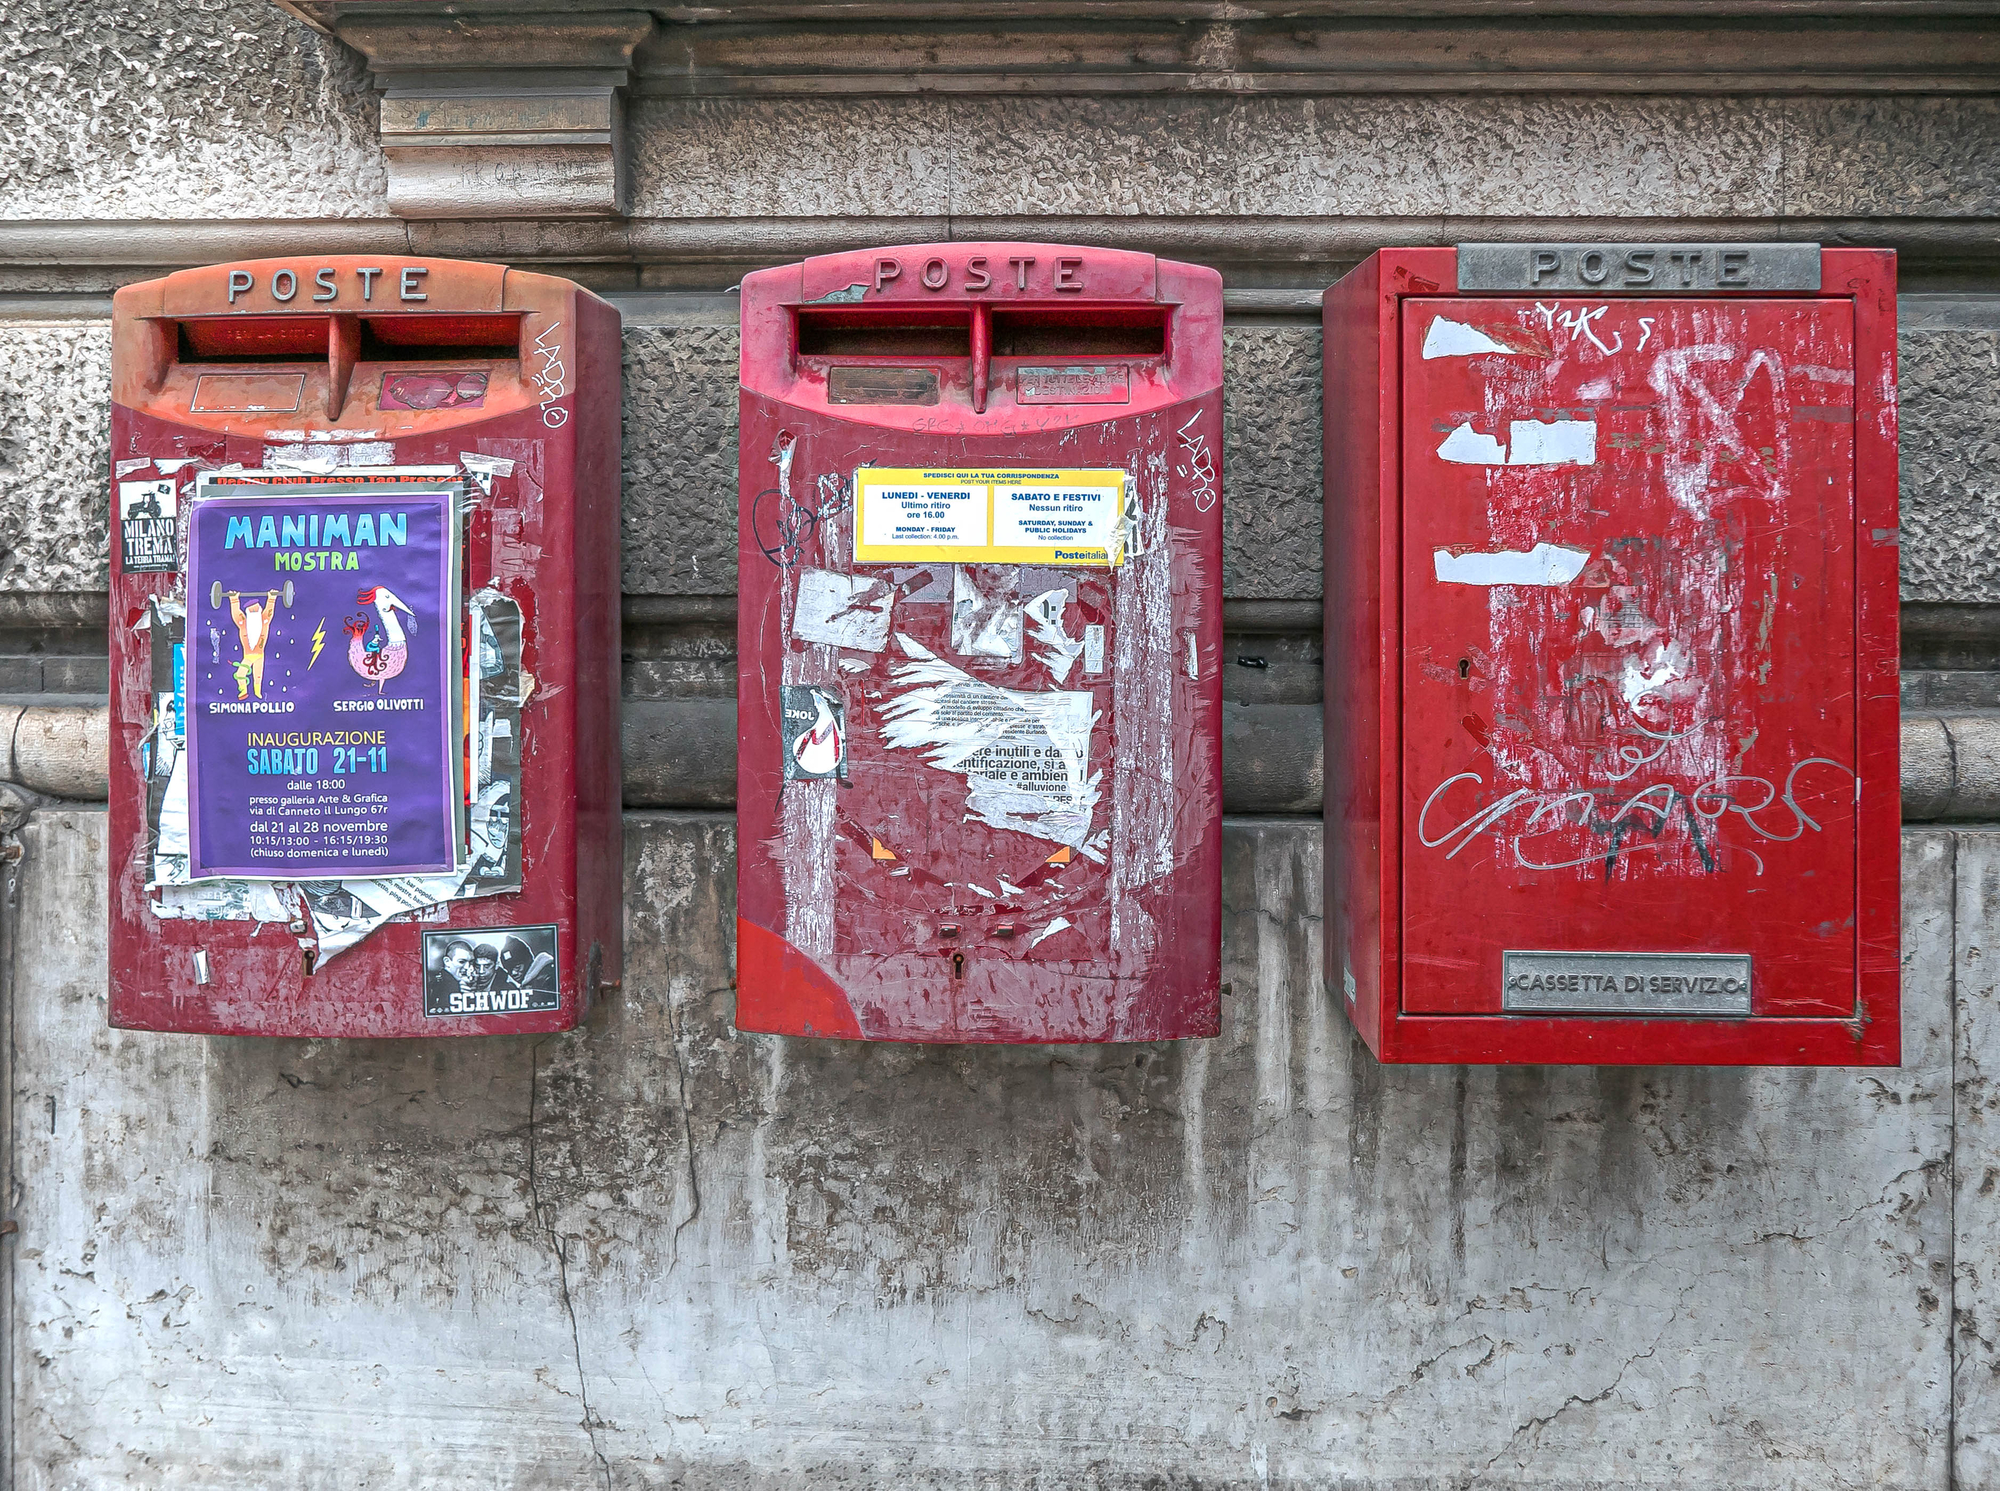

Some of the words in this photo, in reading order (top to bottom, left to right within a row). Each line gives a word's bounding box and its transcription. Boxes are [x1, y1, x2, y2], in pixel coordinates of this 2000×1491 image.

[875, 256, 1084, 293] POSTE
[1530, 250, 1750, 286] POSTE
[228, 267, 430, 304] POSTE
[533, 320, 569, 430] LADRO
[882, 491, 918, 500] LUNEDI
[927, 491, 971, 500] VENERDI
[1011, 493, 1051, 501] SABATO
[1053, 493, 1060, 501] E
[1063, 493, 1101, 502] FESTIVI
[901, 501, 929, 509] Ultimo
[931, 501, 951, 509] ritiro
[1029, 503, 1061, 511] Nessun
[1063, 503, 1083, 512] ritiro
[923, 511, 945, 519] 16.00
[124, 519, 175, 538] MILANO
[224, 513, 408, 550] MANIMAN
[126, 537, 173, 556] TREMA
[125, 556, 134, 565] LA
[133, 555, 153, 564] TERRA
[274, 551, 360, 572] MOSTRA
[1054, 550, 1108, 560] Posteitalia
[208, 701, 251, 714] SIMONA
[252, 701, 296, 714] POLLIO
[332, 700, 375, 712] SERGIO
[376, 698, 425, 711] OLIVOTTI
[247, 730, 386, 747] INAUGURAZIONE
[995, 745, 1030, 758] inutili
[1033, 747, 1042, 758] e
[247, 747, 319, 775] SABATO
[333, 746, 388, 774] 21-11
[1010, 772, 1018, 780] e
[287, 779, 312, 790] dalle
[315, 779, 346, 790] 18:00
[1016, 782, 1066, 792] #alluvione
[250, 796, 278, 805] presso
[280, 795, 315, 806] galleria
[317, 794, 339, 804] Arte
[341, 794, 351, 804] &
[353, 793, 388, 803] Grafica
[249, 806, 263, 815] via
[266, 806, 276, 816] di
[278, 806, 321, 816] Canneto
[324, 805, 331, 815] il
[334, 805, 368, 816] Lungo
[370, 804, 388, 814] 67r
[249, 820, 269, 833] dal
[271, 821, 284, 833] 21
[288, 820, 300, 833] al
[303, 821, 320, 833] 28
[323, 820, 389, 832] novembre
[250, 835, 310, 846] 10:15/13:00
[323, 835, 388, 845] 16:15/19:30
[250, 847, 285, 859] (chiuso
[287, 848, 339, 858] domenica
[342, 849, 349, 857] e
[351, 846, 389, 857] lunedì)
[1516, 973, 1618, 993] CASSETTA
[1624, 975, 1644, 993] DI
[1650, 976, 1741, 994] SERVIZIO
[449, 989, 534, 1013] SCHWOF
